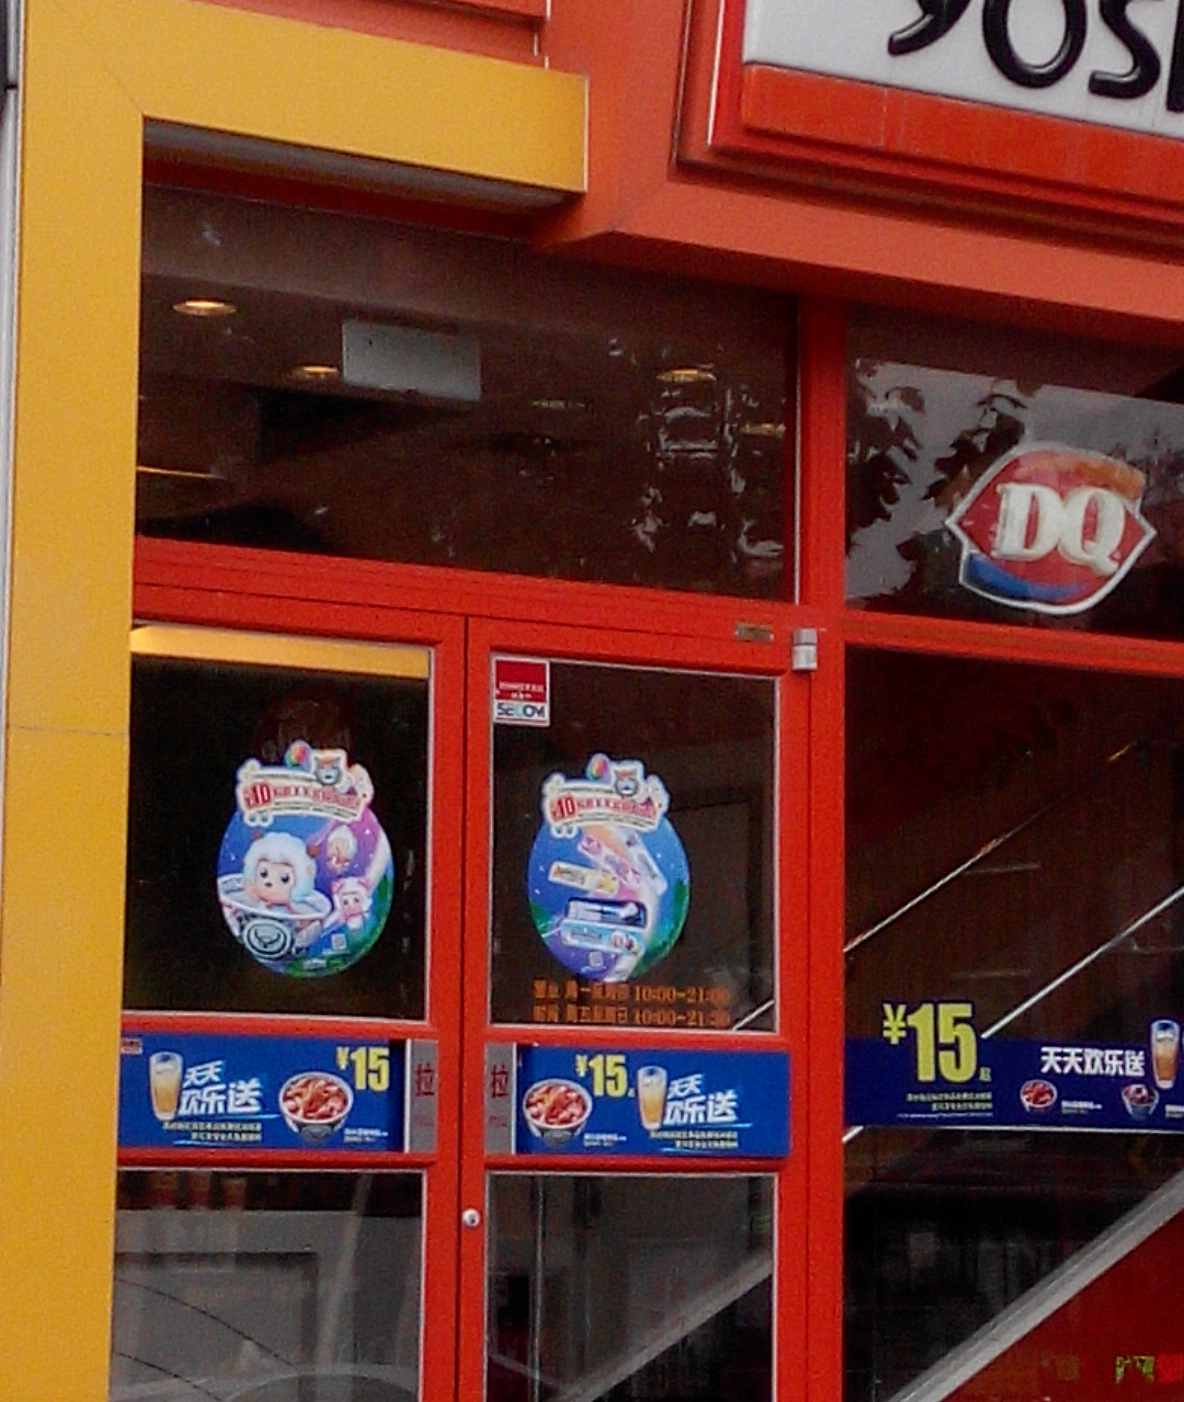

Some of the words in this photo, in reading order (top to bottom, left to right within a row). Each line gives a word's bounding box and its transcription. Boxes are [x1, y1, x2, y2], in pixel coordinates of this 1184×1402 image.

[990, 482, 1131, 576] DQ
[883, 1003, 977, 1082] ¥15
[1040, 1046, 1146, 1077] 天天欢乐送
[183, 1060, 225, 1088] 天天
[336, 1046, 390, 1092] ¥15
[415, 1062, 435, 1096] 拉
[491, 1064, 510, 1098] 拉
[575, 1054, 628, 1097] ¥15
